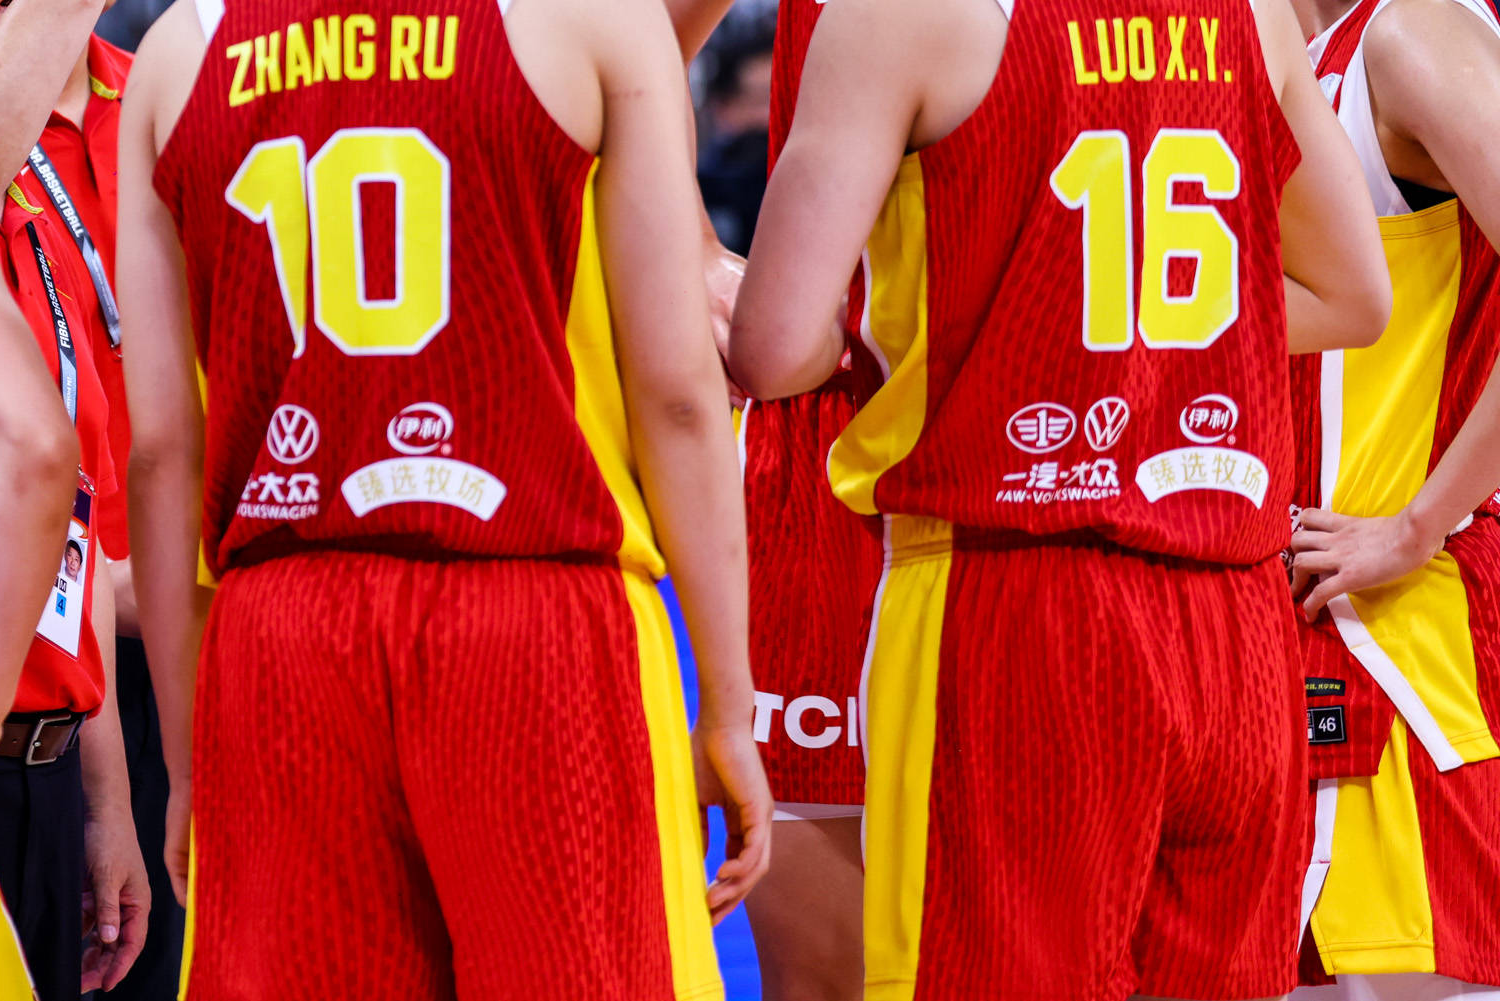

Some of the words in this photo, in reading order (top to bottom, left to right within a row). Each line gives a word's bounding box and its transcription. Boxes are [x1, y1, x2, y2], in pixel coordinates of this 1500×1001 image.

[226, 14, 376, 107] ZHANG
[390, 15, 459, 81] RU
[1067, 16, 1157, 85] LUO
[1165, 16, 1232, 83] X.Y.
[225, 127, 450, 358] 10
[1050, 128, 1240, 352] 16
[1187, 407, 1230, 430] 伊利
[356, 463, 488, 507] 臻选牧场
[1148, 452, 1262, 497] 臻选牧场
[1318, 716, 1337, 733] 46
